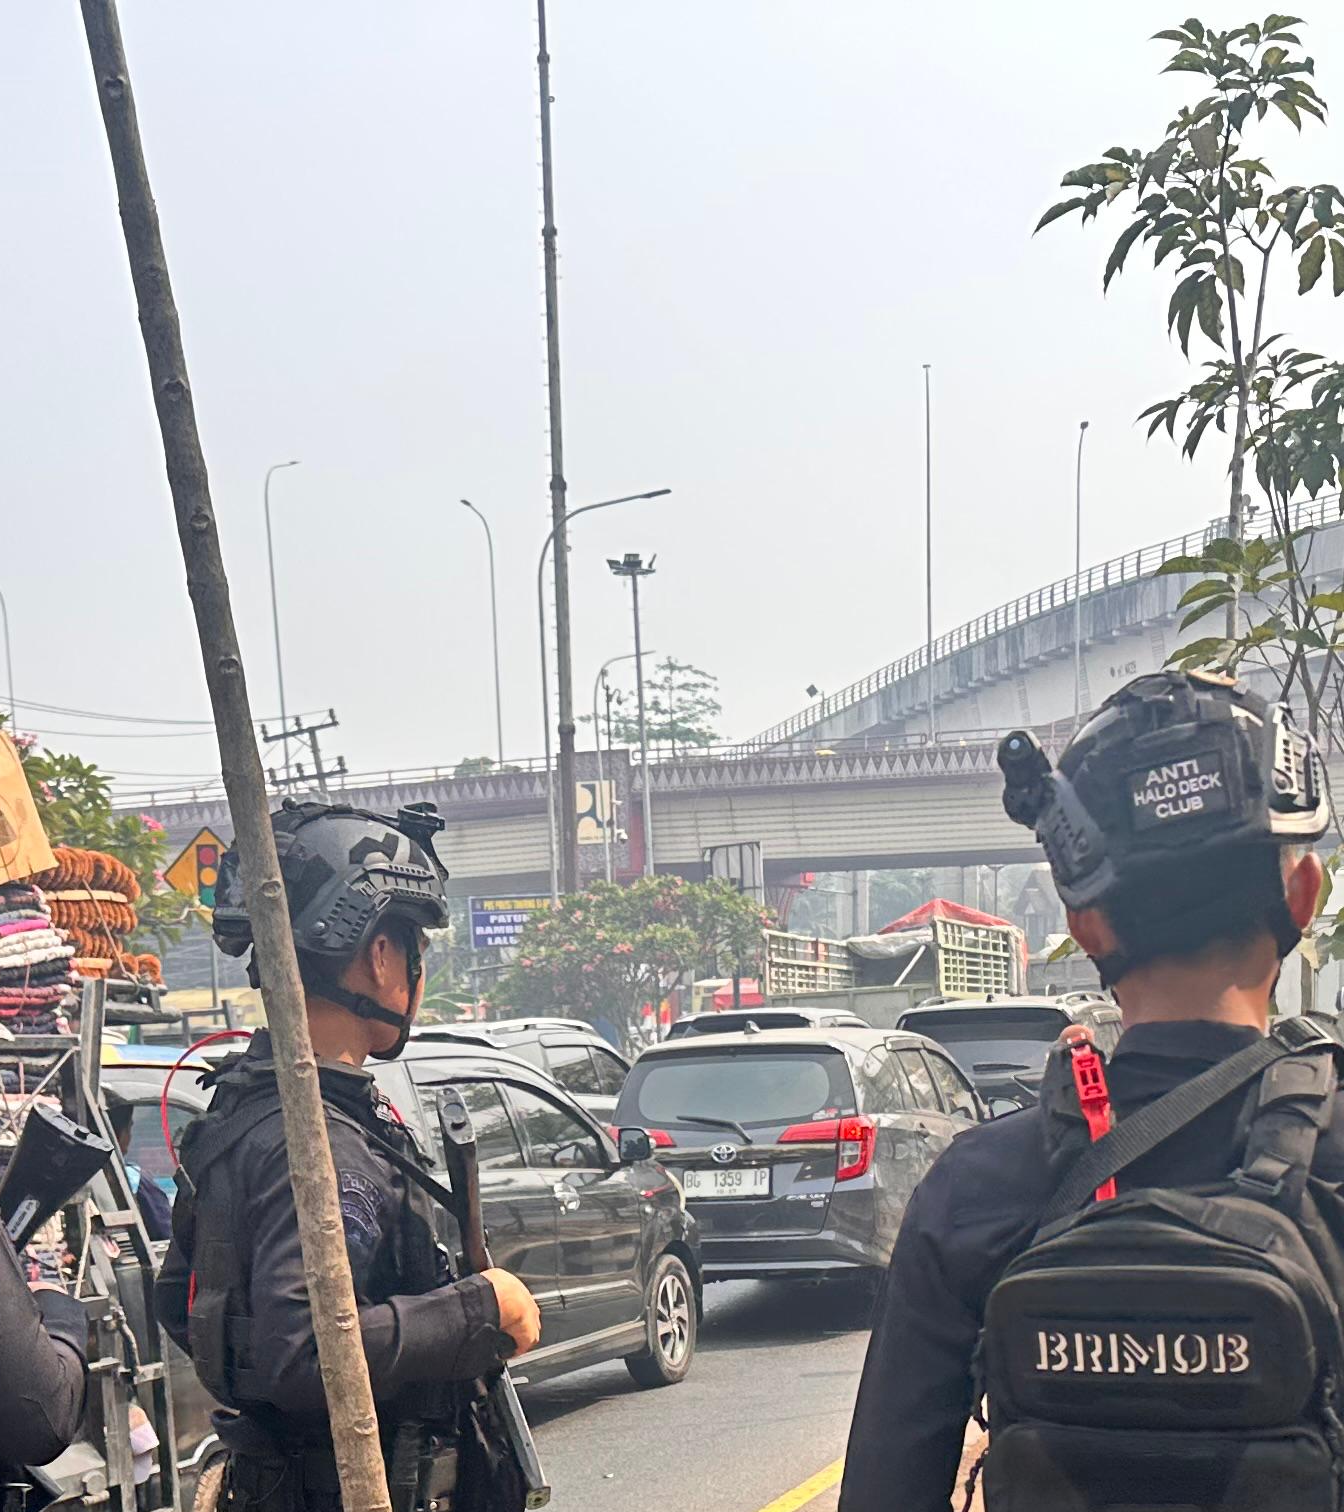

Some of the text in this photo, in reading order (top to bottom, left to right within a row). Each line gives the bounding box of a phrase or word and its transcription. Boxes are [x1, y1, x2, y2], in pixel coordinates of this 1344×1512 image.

[1146, 759, 1199, 786] ANTI
[1133, 771, 1222, 807] HALO DECK
[1155, 795, 1204, 818] CLUB
[686, 1170, 767, 1188] BG 1359 IP
[1035, 1331, 1250, 1375] BRIMOB
